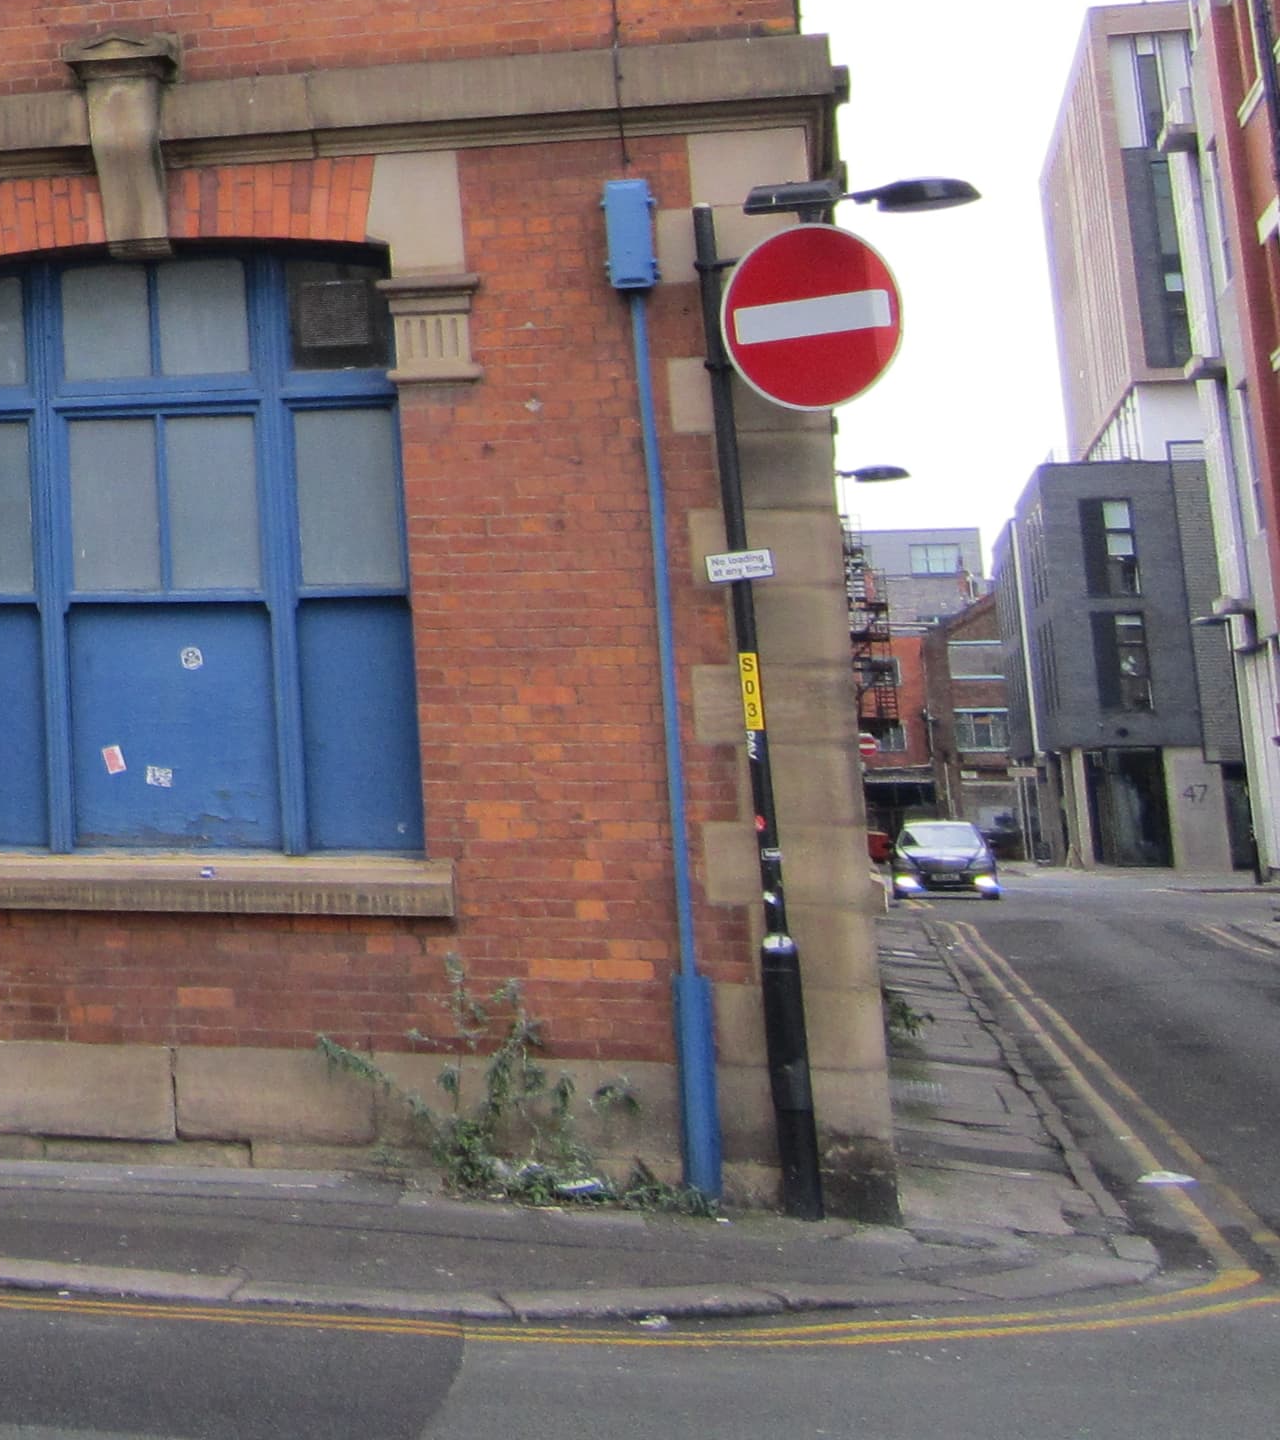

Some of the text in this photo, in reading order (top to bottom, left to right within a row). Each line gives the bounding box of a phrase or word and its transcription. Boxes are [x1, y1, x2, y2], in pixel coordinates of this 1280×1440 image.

[712, 555, 764, 566] No loading
[1183, 784, 1208, 803] 47
